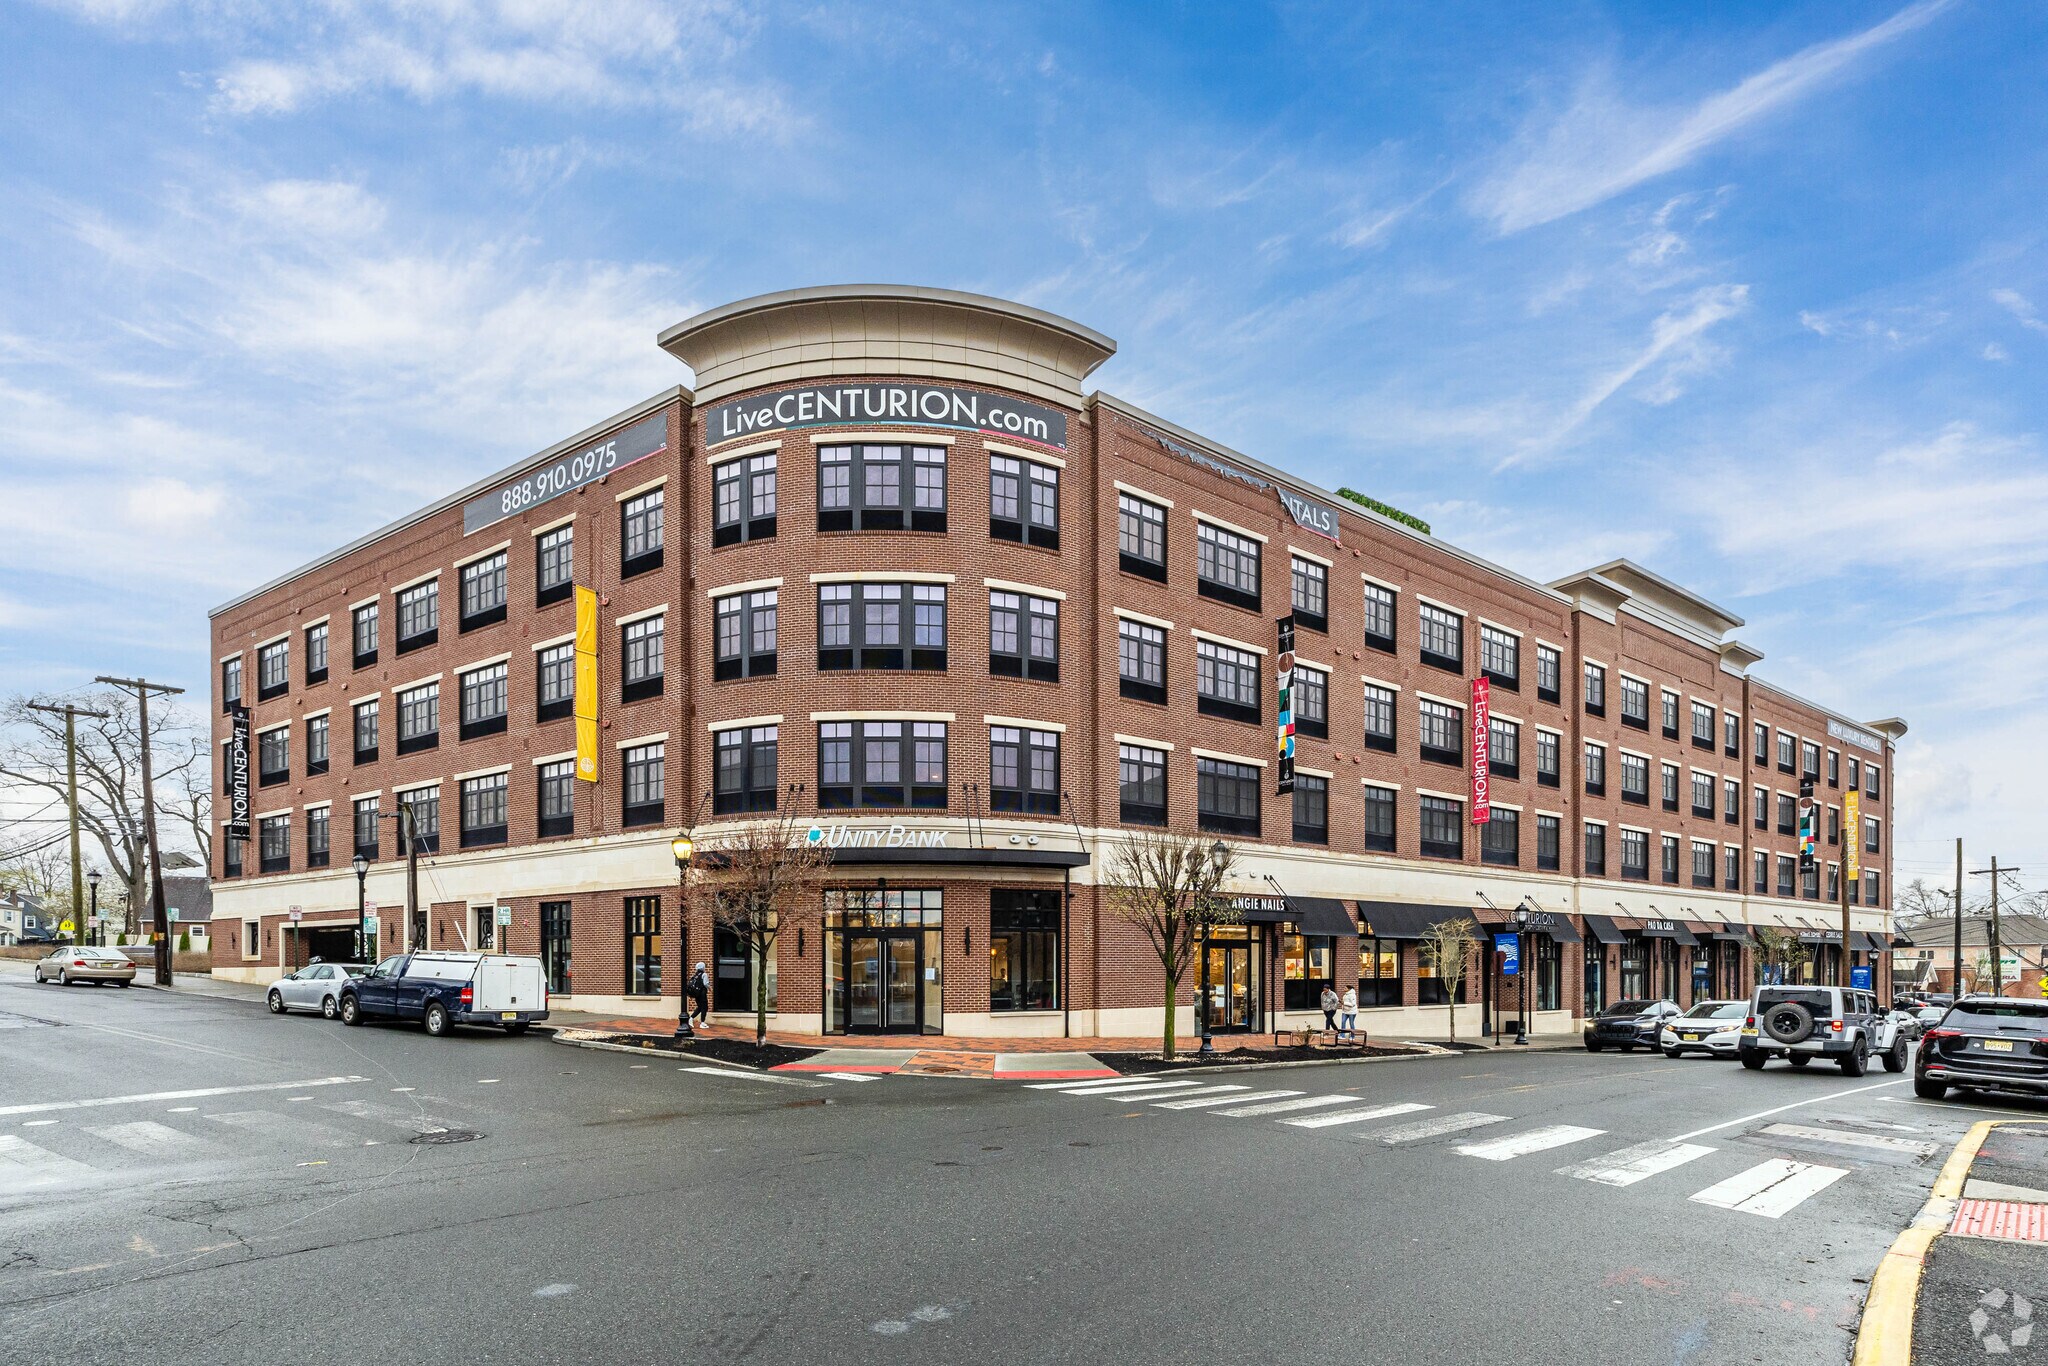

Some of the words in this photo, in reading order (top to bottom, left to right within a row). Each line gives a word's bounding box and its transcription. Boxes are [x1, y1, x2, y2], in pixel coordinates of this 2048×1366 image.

[722, 388, 1048, 440] LiveCENTURION.com
[501, 441, 617, 514] 888.910.0975
[1231, 897, 1259, 910] ANGIE
[1261, 898, 1285, 911] NAILS
